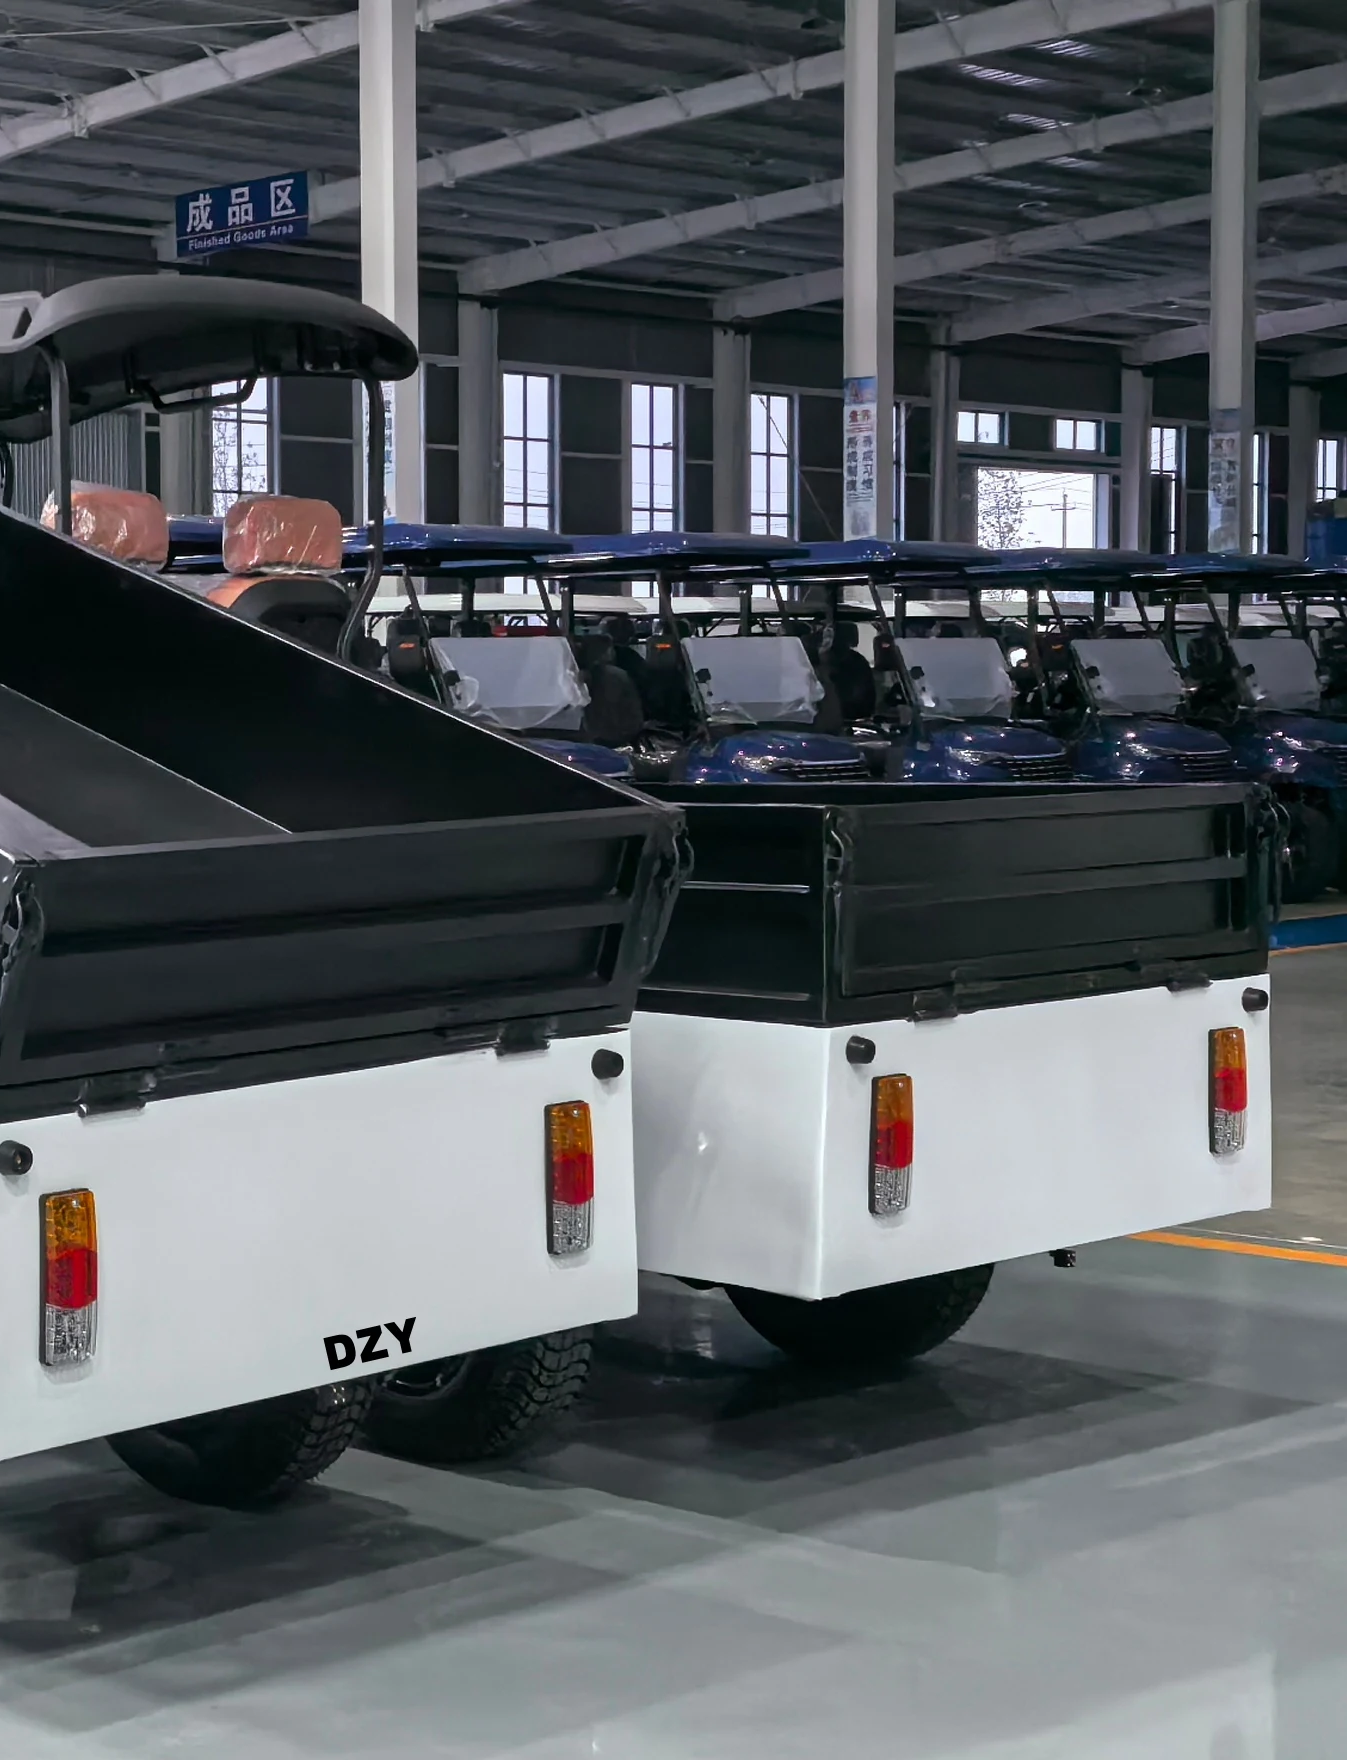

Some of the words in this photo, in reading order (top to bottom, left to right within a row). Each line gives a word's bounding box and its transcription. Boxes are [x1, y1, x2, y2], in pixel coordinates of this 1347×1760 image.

[186, 178, 296, 233] 成品区
[188, 232, 231, 250] Finished
[233, 228, 267, 243] Goods
[269, 223, 294, 238] Area
[323, 1316, 417, 1371] DZY
